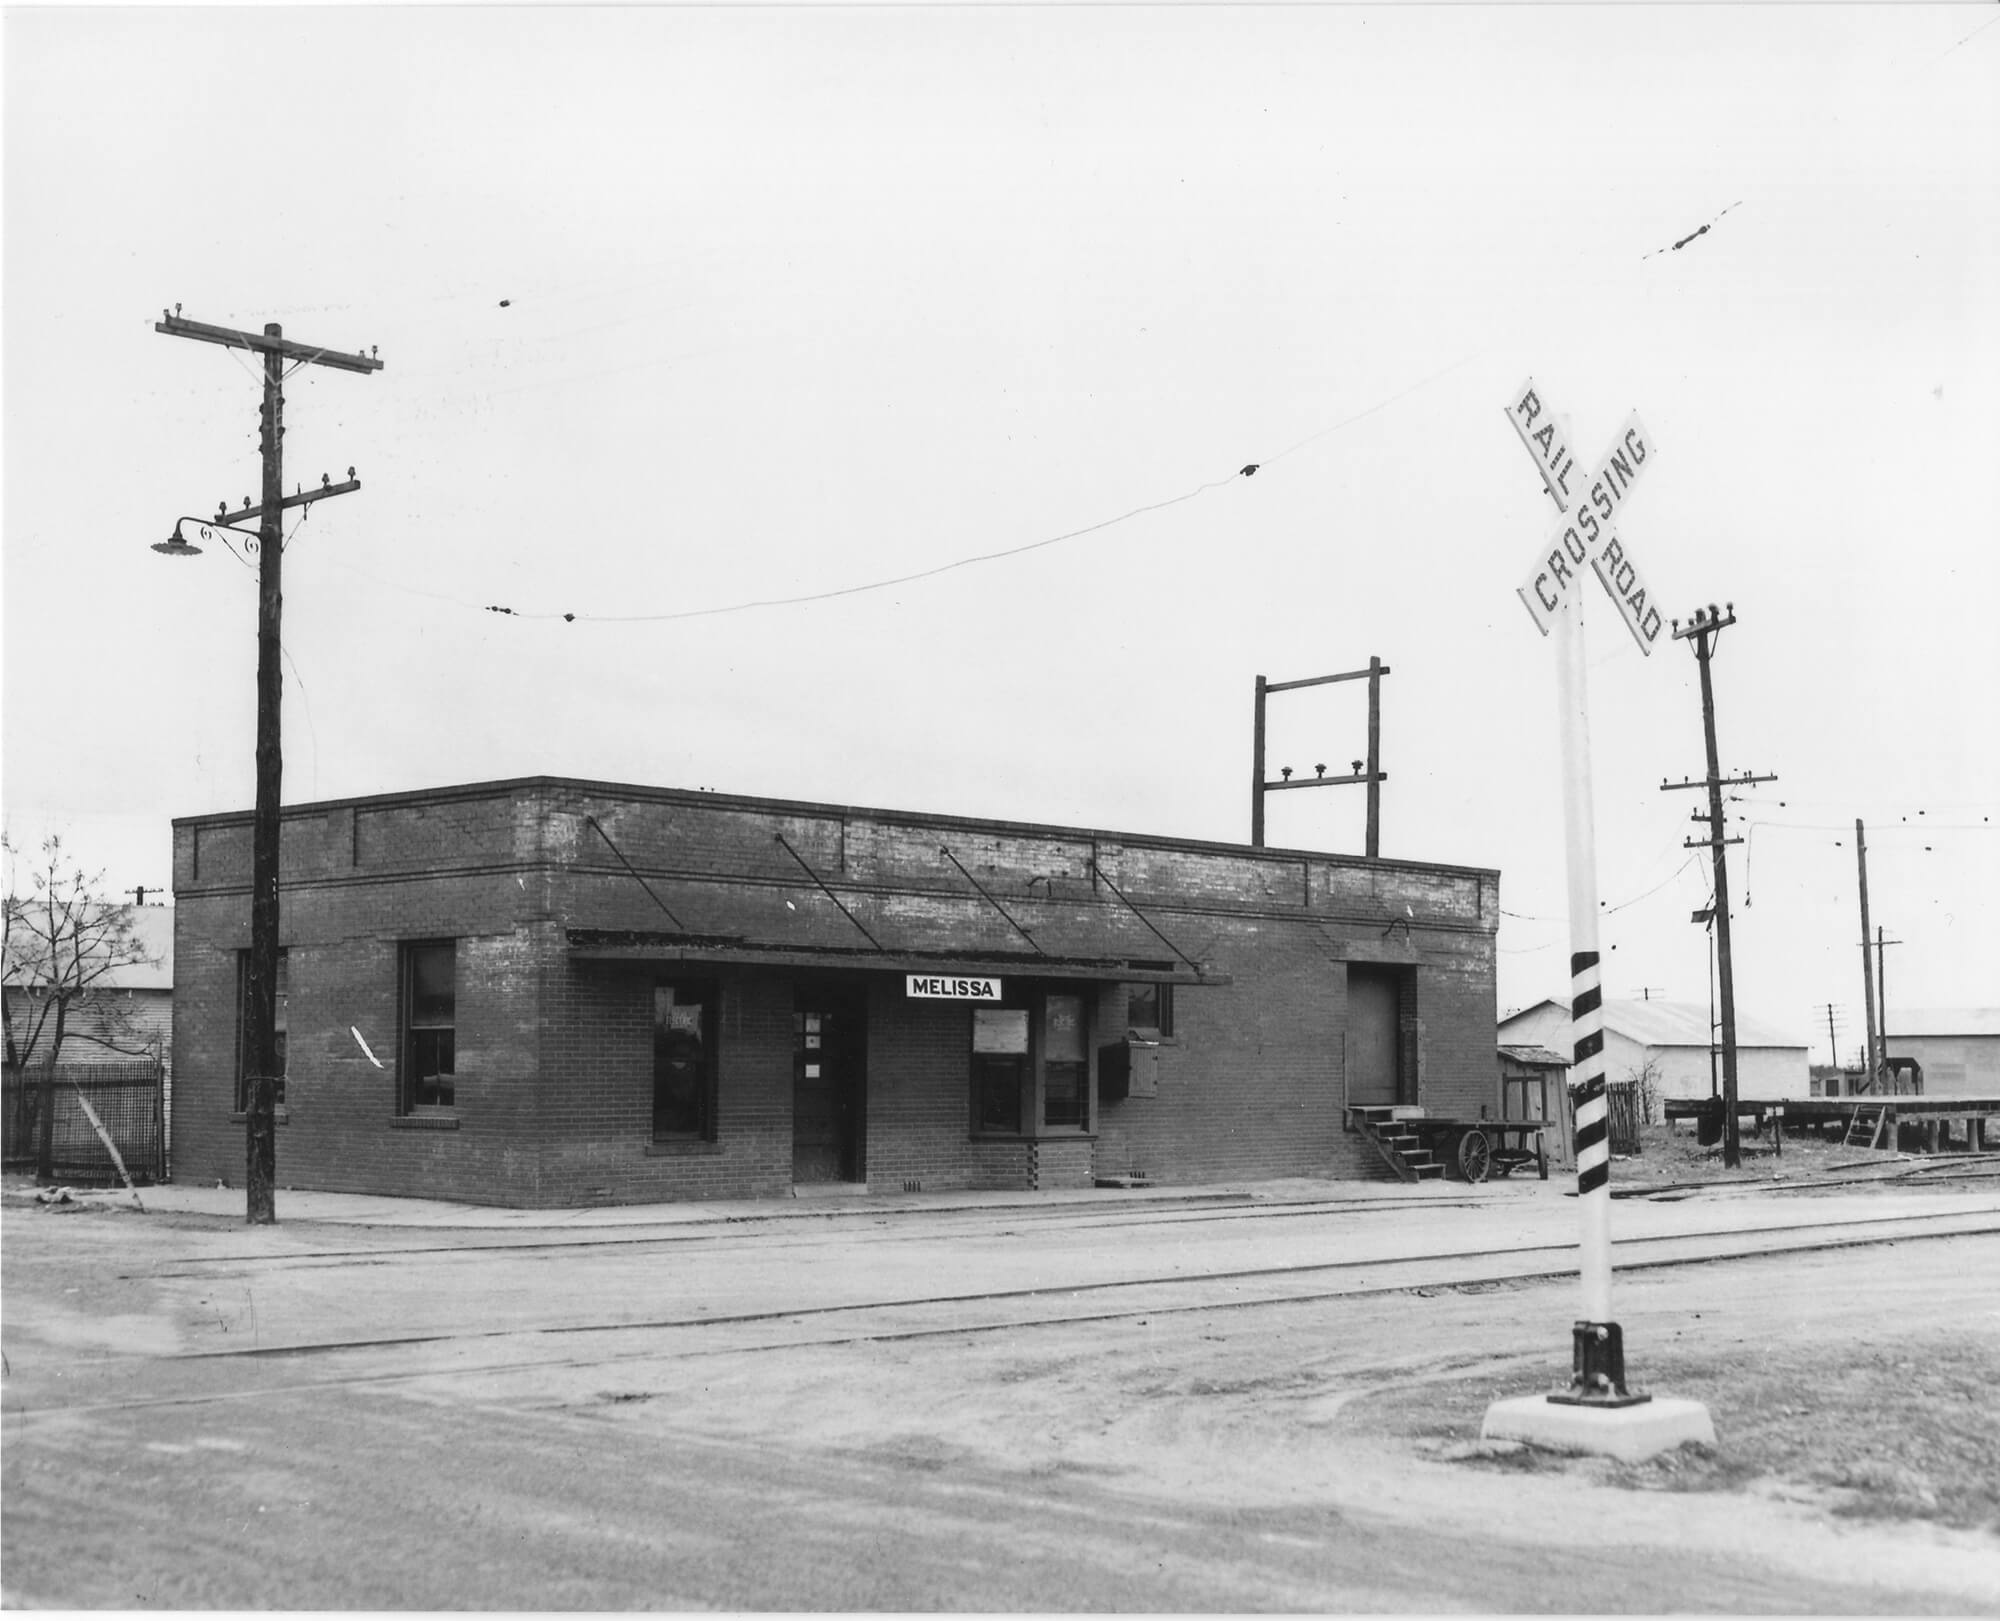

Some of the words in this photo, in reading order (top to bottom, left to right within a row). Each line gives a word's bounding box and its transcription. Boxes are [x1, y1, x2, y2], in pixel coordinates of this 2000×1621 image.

[1517, 388, 1573, 496] RAIL
[1601, 537, 1662, 642] ROAD
[1534, 428, 1646, 612] CROSSING
[912, 978, 994, 997] MELISSA
